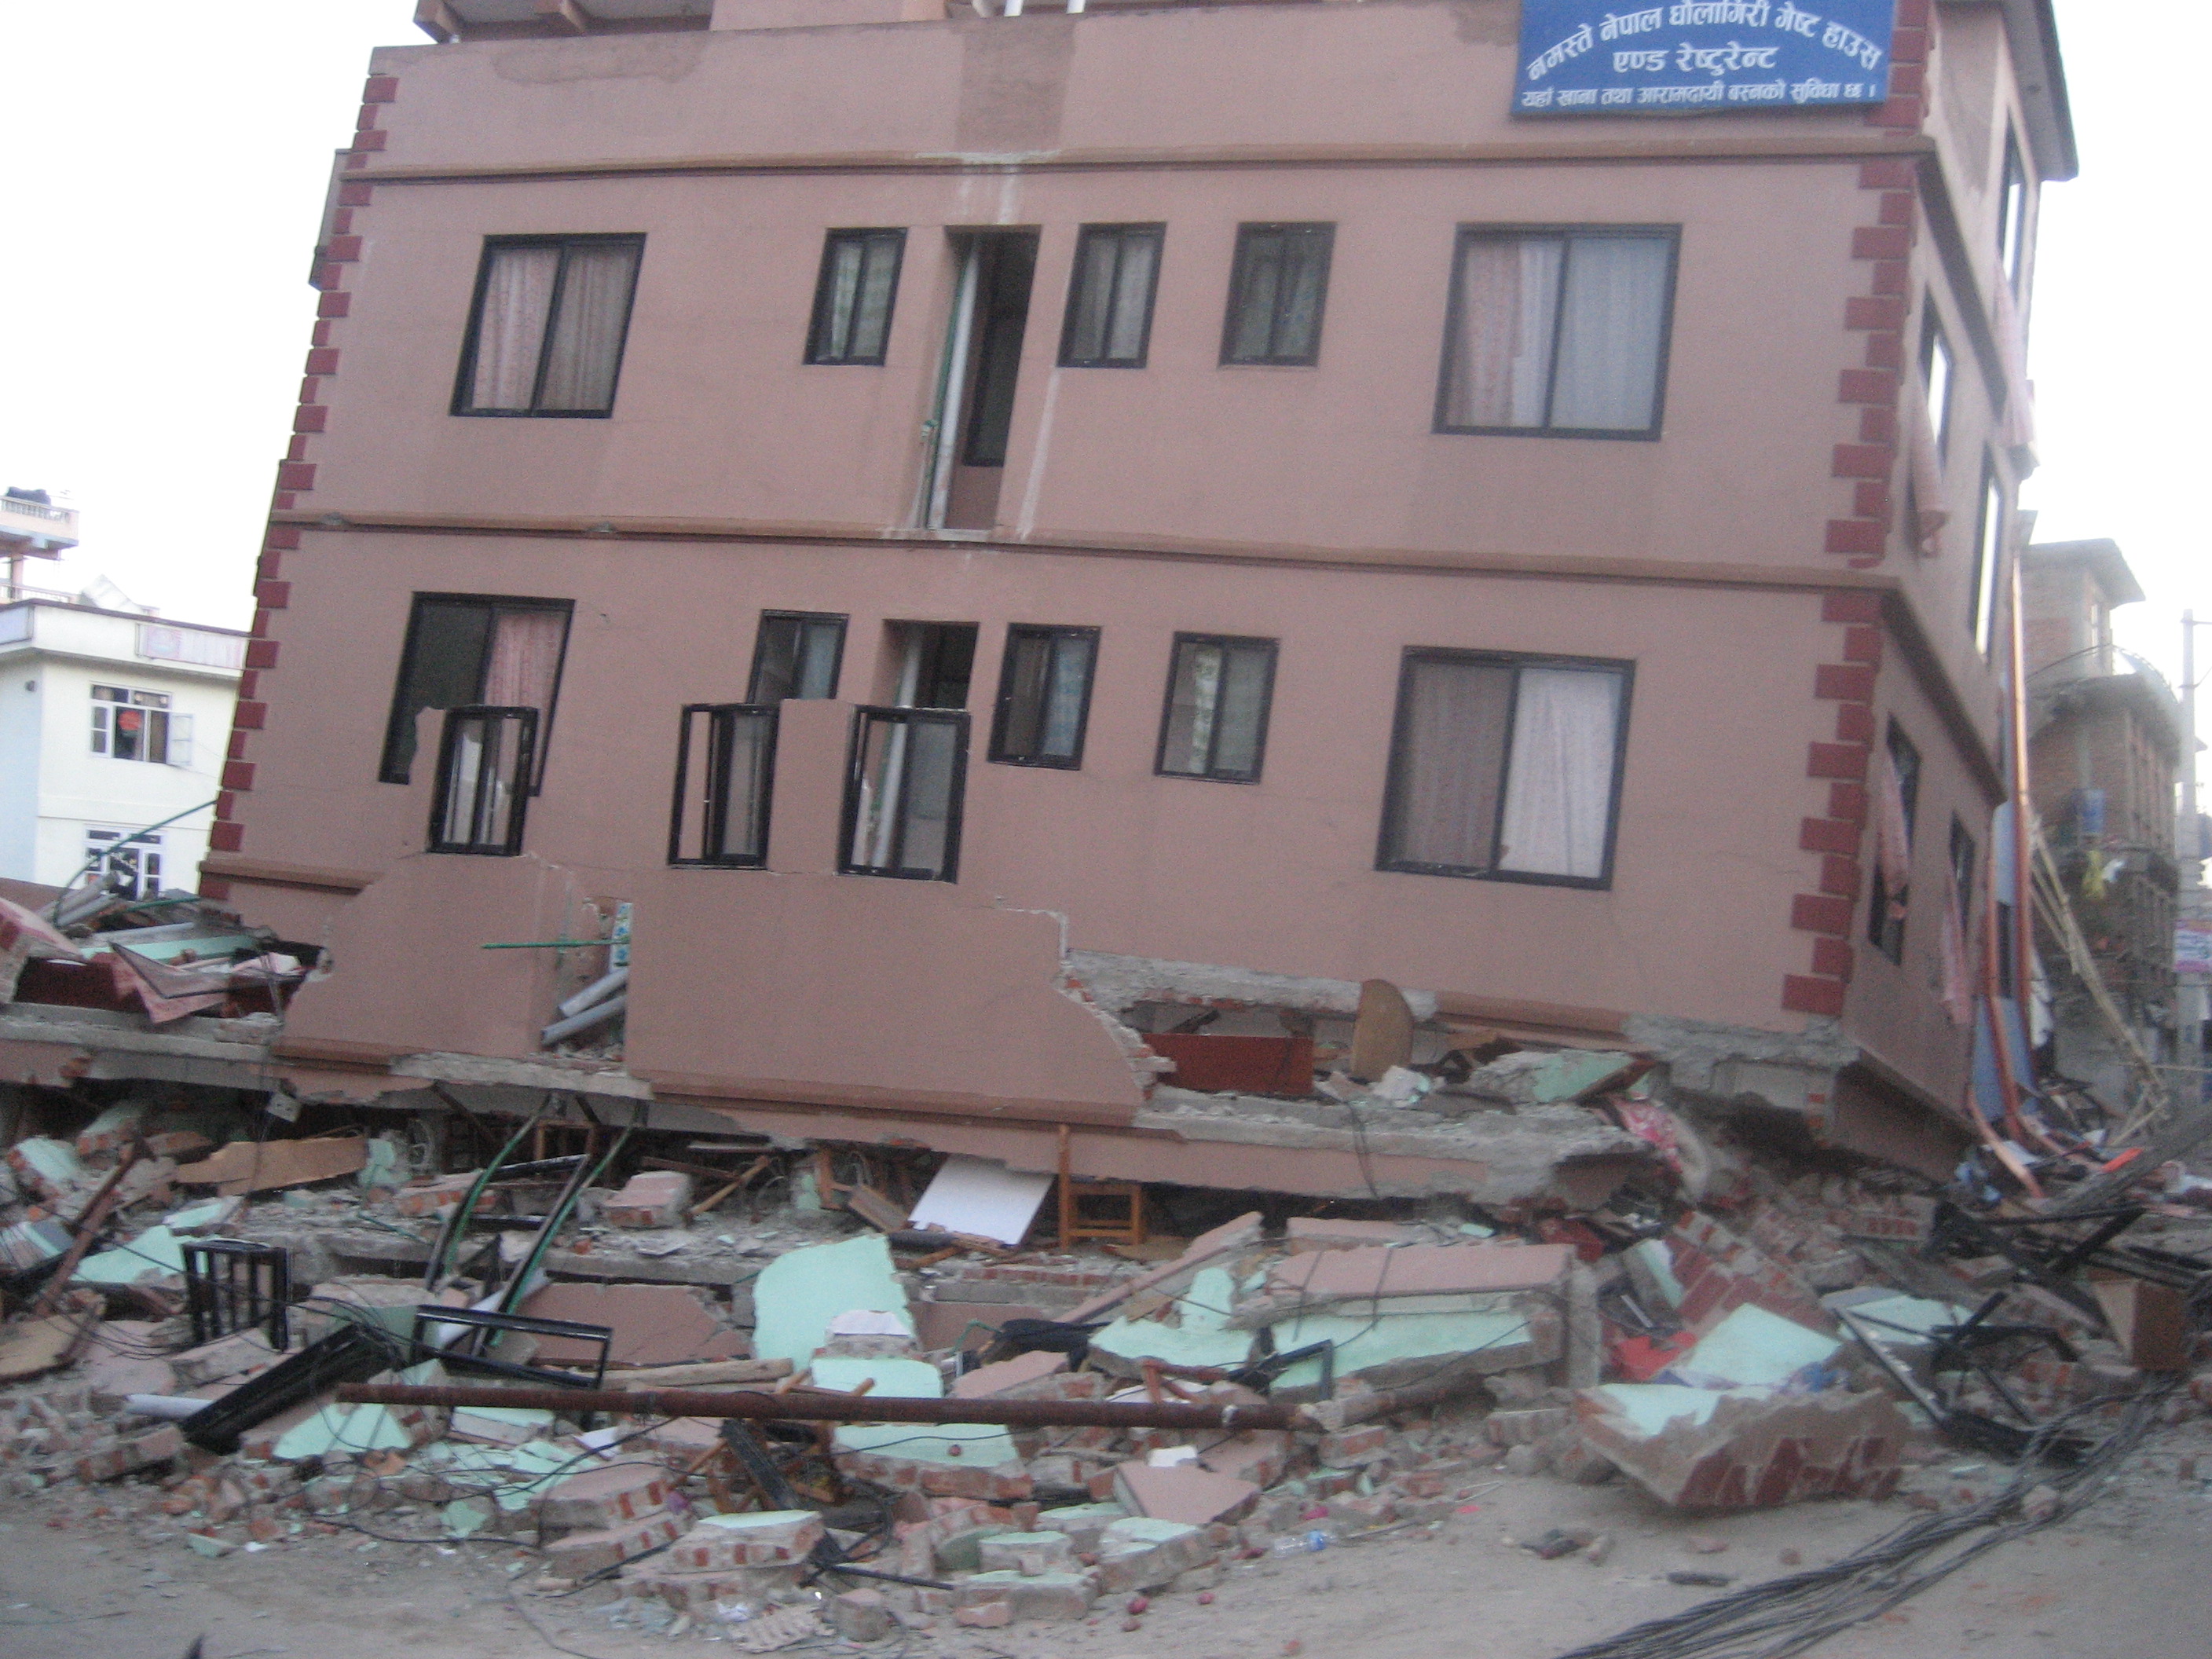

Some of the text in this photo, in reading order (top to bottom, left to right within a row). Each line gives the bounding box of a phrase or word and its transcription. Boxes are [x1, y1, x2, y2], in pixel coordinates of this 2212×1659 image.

[1527, 23, 1594, 80] नमस्ते
[1599, 7, 1664, 40] नेपाल
[1822, 20, 1883, 71] हाउस
[1613, 49, 1669, 73] एण्ड
